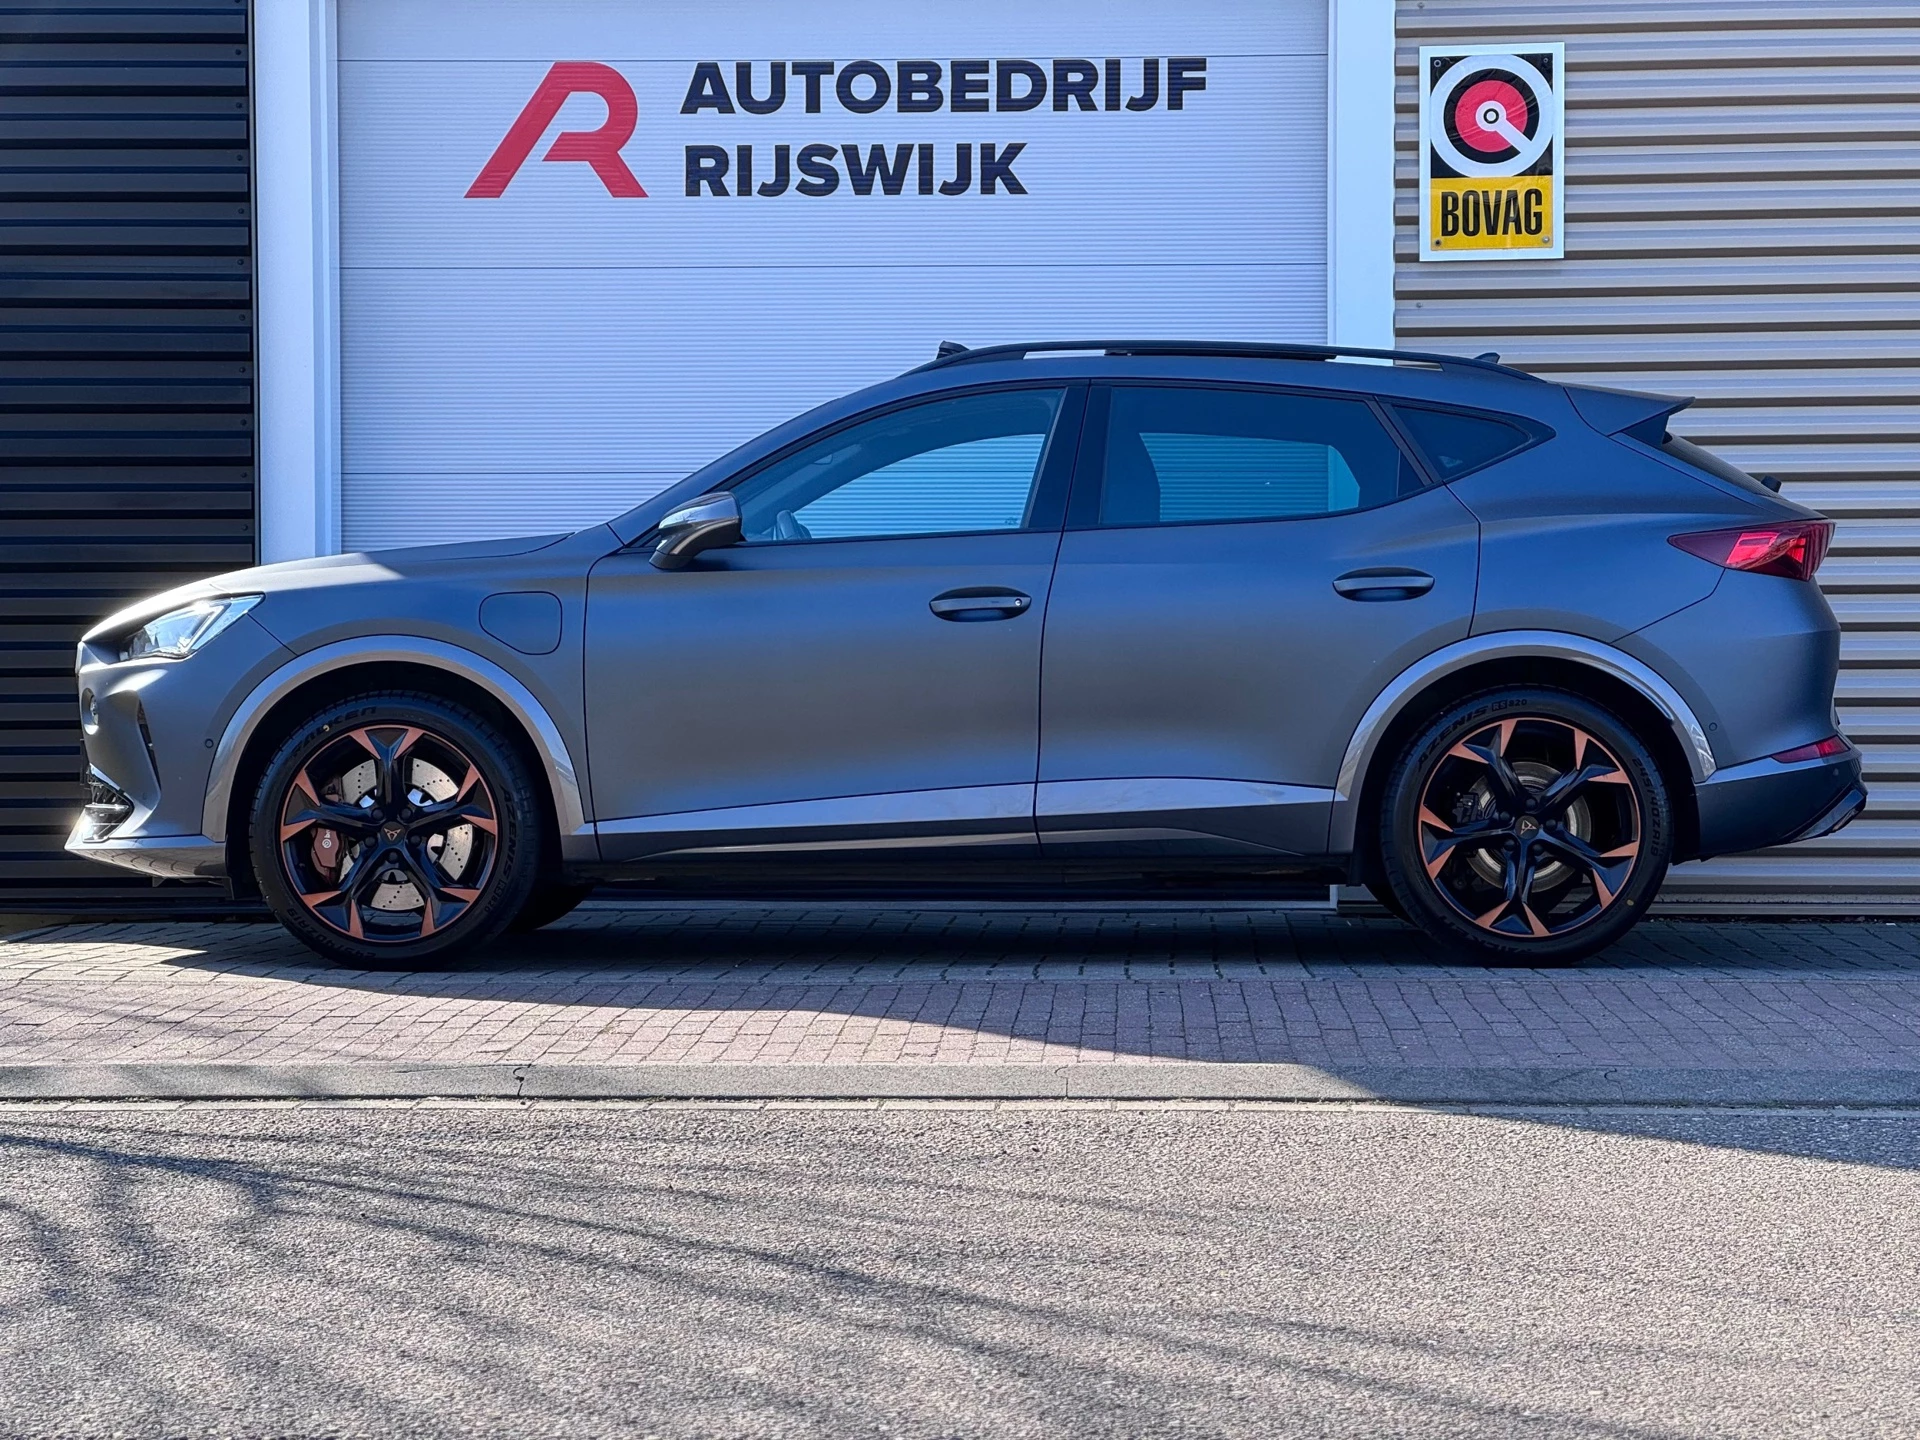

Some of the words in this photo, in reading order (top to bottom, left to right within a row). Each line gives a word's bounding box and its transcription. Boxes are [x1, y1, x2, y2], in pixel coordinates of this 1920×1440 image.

[680, 58, 1207, 114] AUTOBEDRIJF
[685, 142, 1028, 197] RIJSWIJK
[1441, 188, 1542, 236] BOVAG
